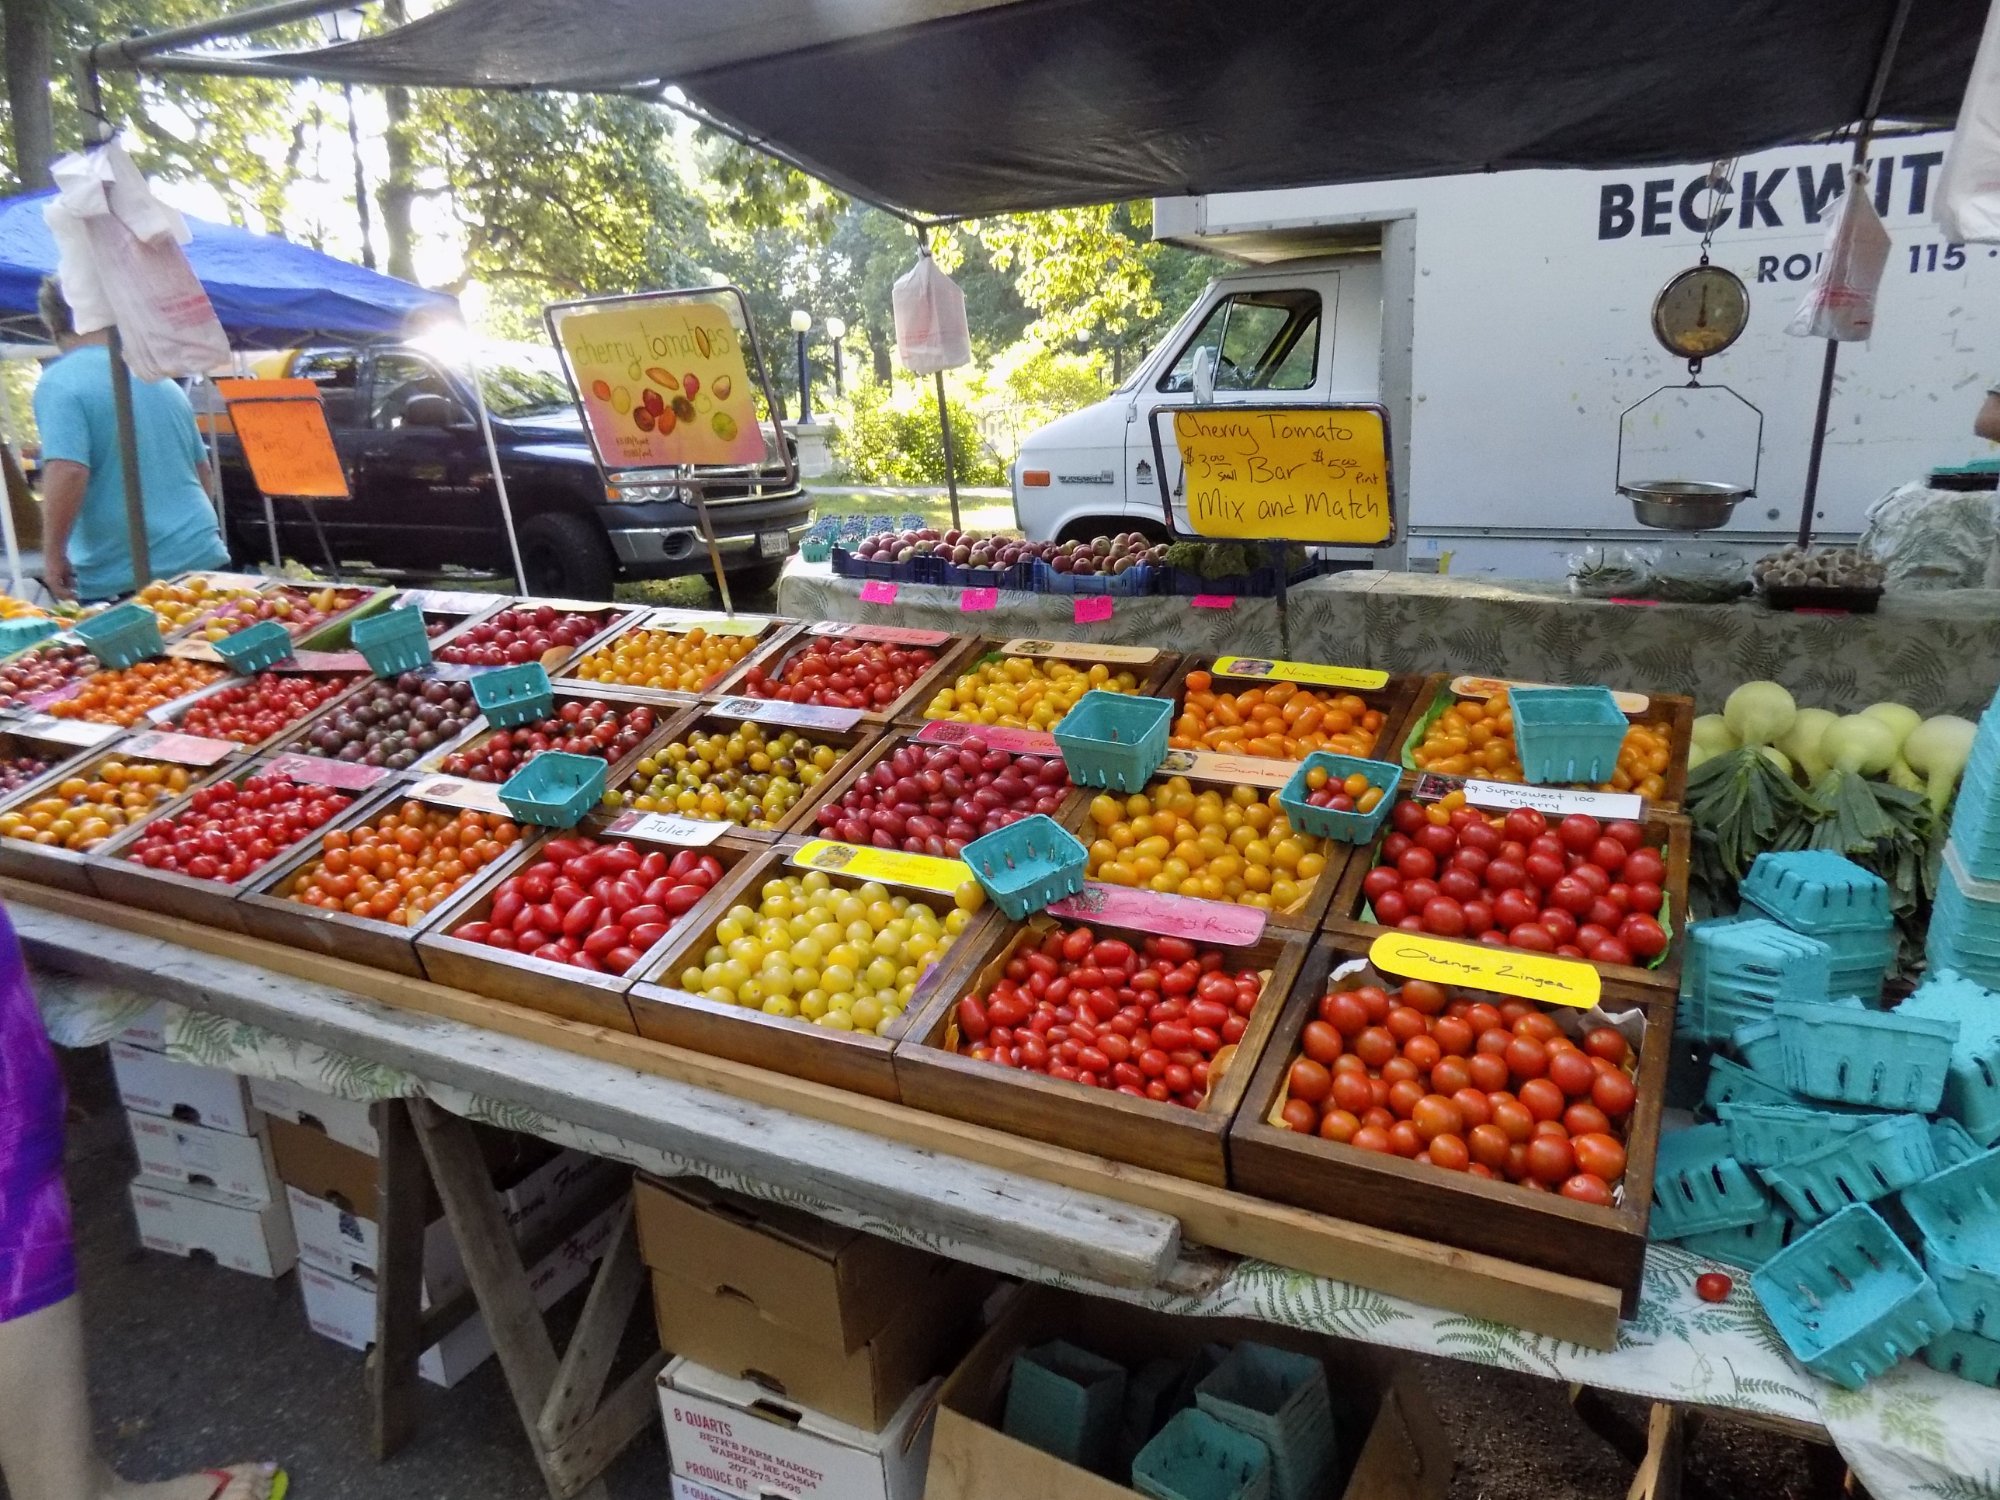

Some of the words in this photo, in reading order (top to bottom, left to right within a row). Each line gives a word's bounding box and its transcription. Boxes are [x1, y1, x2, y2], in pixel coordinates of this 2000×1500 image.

[1909, 243, 1966, 274] 115
[575, 334, 642, 366] cherry
[640, 316, 730, 360] tomatoes
[1176, 411, 1259, 455] Cherry
[1257, 414, 1353, 442] Tomato
[1248, 457, 1307, 483] Bar
[1198, 488, 1246, 522] Mix
[1258, 495, 1297, 520] and
[1305, 490, 1379, 520] Match
[1510, 798, 1561, 812] Cherry
[1574, 795, 1597, 803] 100
[643, 820, 697, 837] Juliet
[1396, 948, 1483, 973] Orange
[1495, 965, 1573, 991] Zinger
[674, 1408, 682, 1422] 8
[685, 1411, 733, 1437] QUARTS
[699, 1431, 739, 1451] BETH'S
[741, 1445, 773, 1463] FARM
[776, 1457, 824, 1481] MARKET
[709, 1445, 760, 1470] WARREN,
[763, 1463, 781, 1476] ME
[685, 1461, 734, 1487] PRODUCE
[735, 1477, 750, 1491] OF
